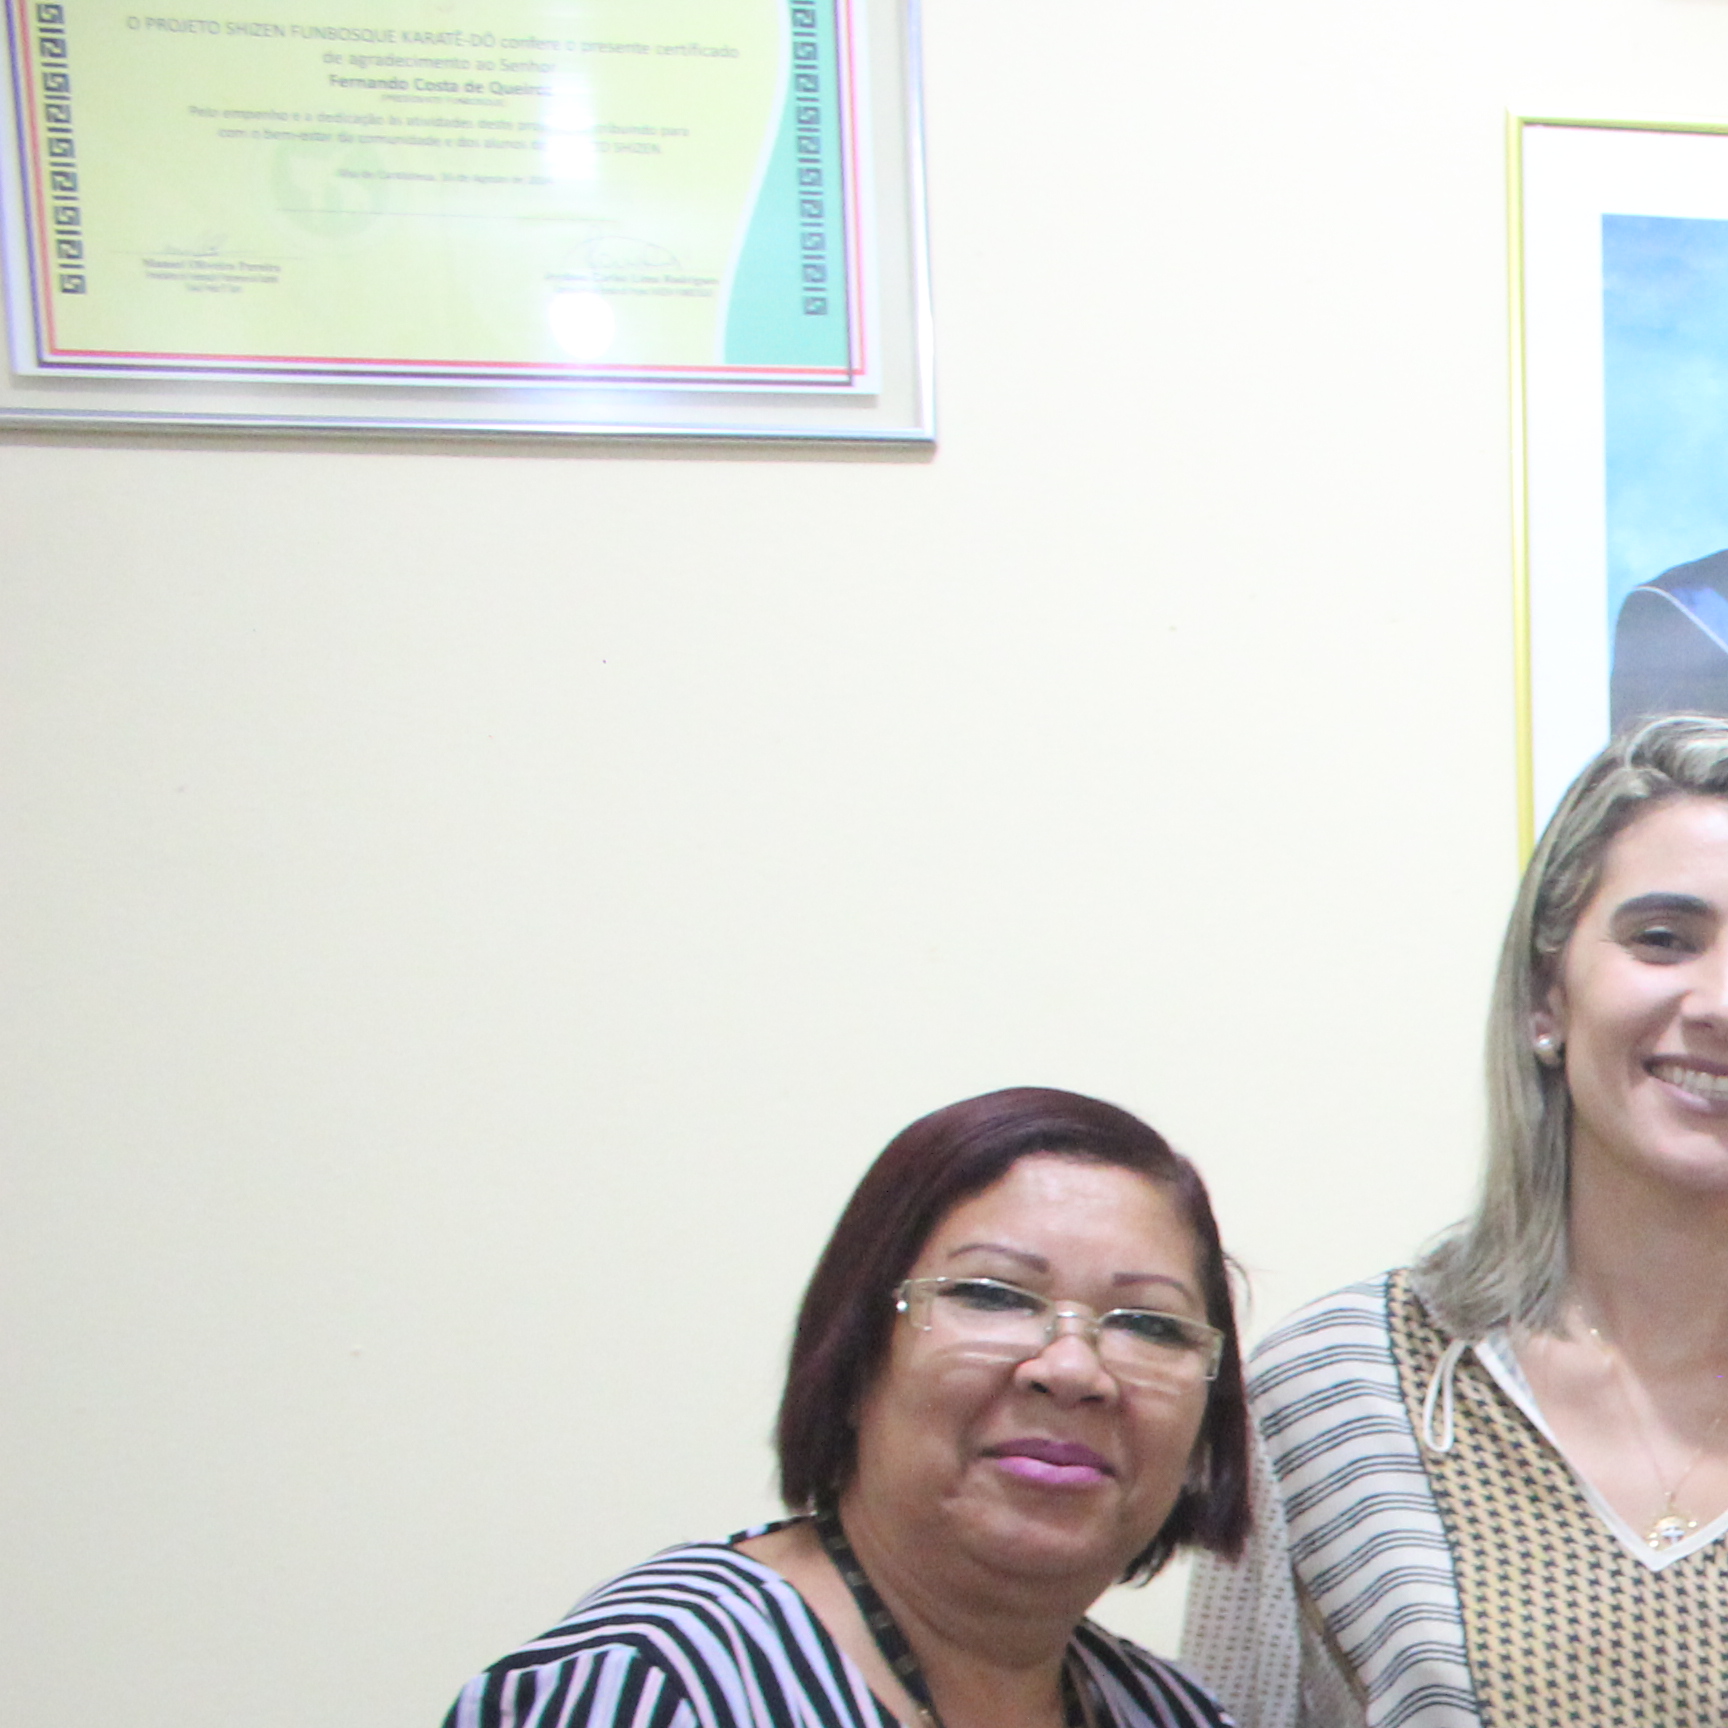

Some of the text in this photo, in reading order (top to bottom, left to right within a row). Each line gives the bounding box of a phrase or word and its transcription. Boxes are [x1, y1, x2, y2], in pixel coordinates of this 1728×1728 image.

[126, 16, 140, 30] O
[145, 16, 221, 35] PROJETO
[226, 21, 286, 37] SHIZEN
[290, 24, 397, 43] FUNBOSQUE
[501, 35, 559, 51] confere
[580, 41, 649, 57] presente
[654, 41, 741, 58] certificado
[322, 50, 342, 64] de
[348, 53, 470, 71] agradecimento
[500, 57, 556, 73] Senhor
[328, 74, 409, 90] Fernando
[413, 78, 459, 92] Costa
[464, 80, 484, 94] de
